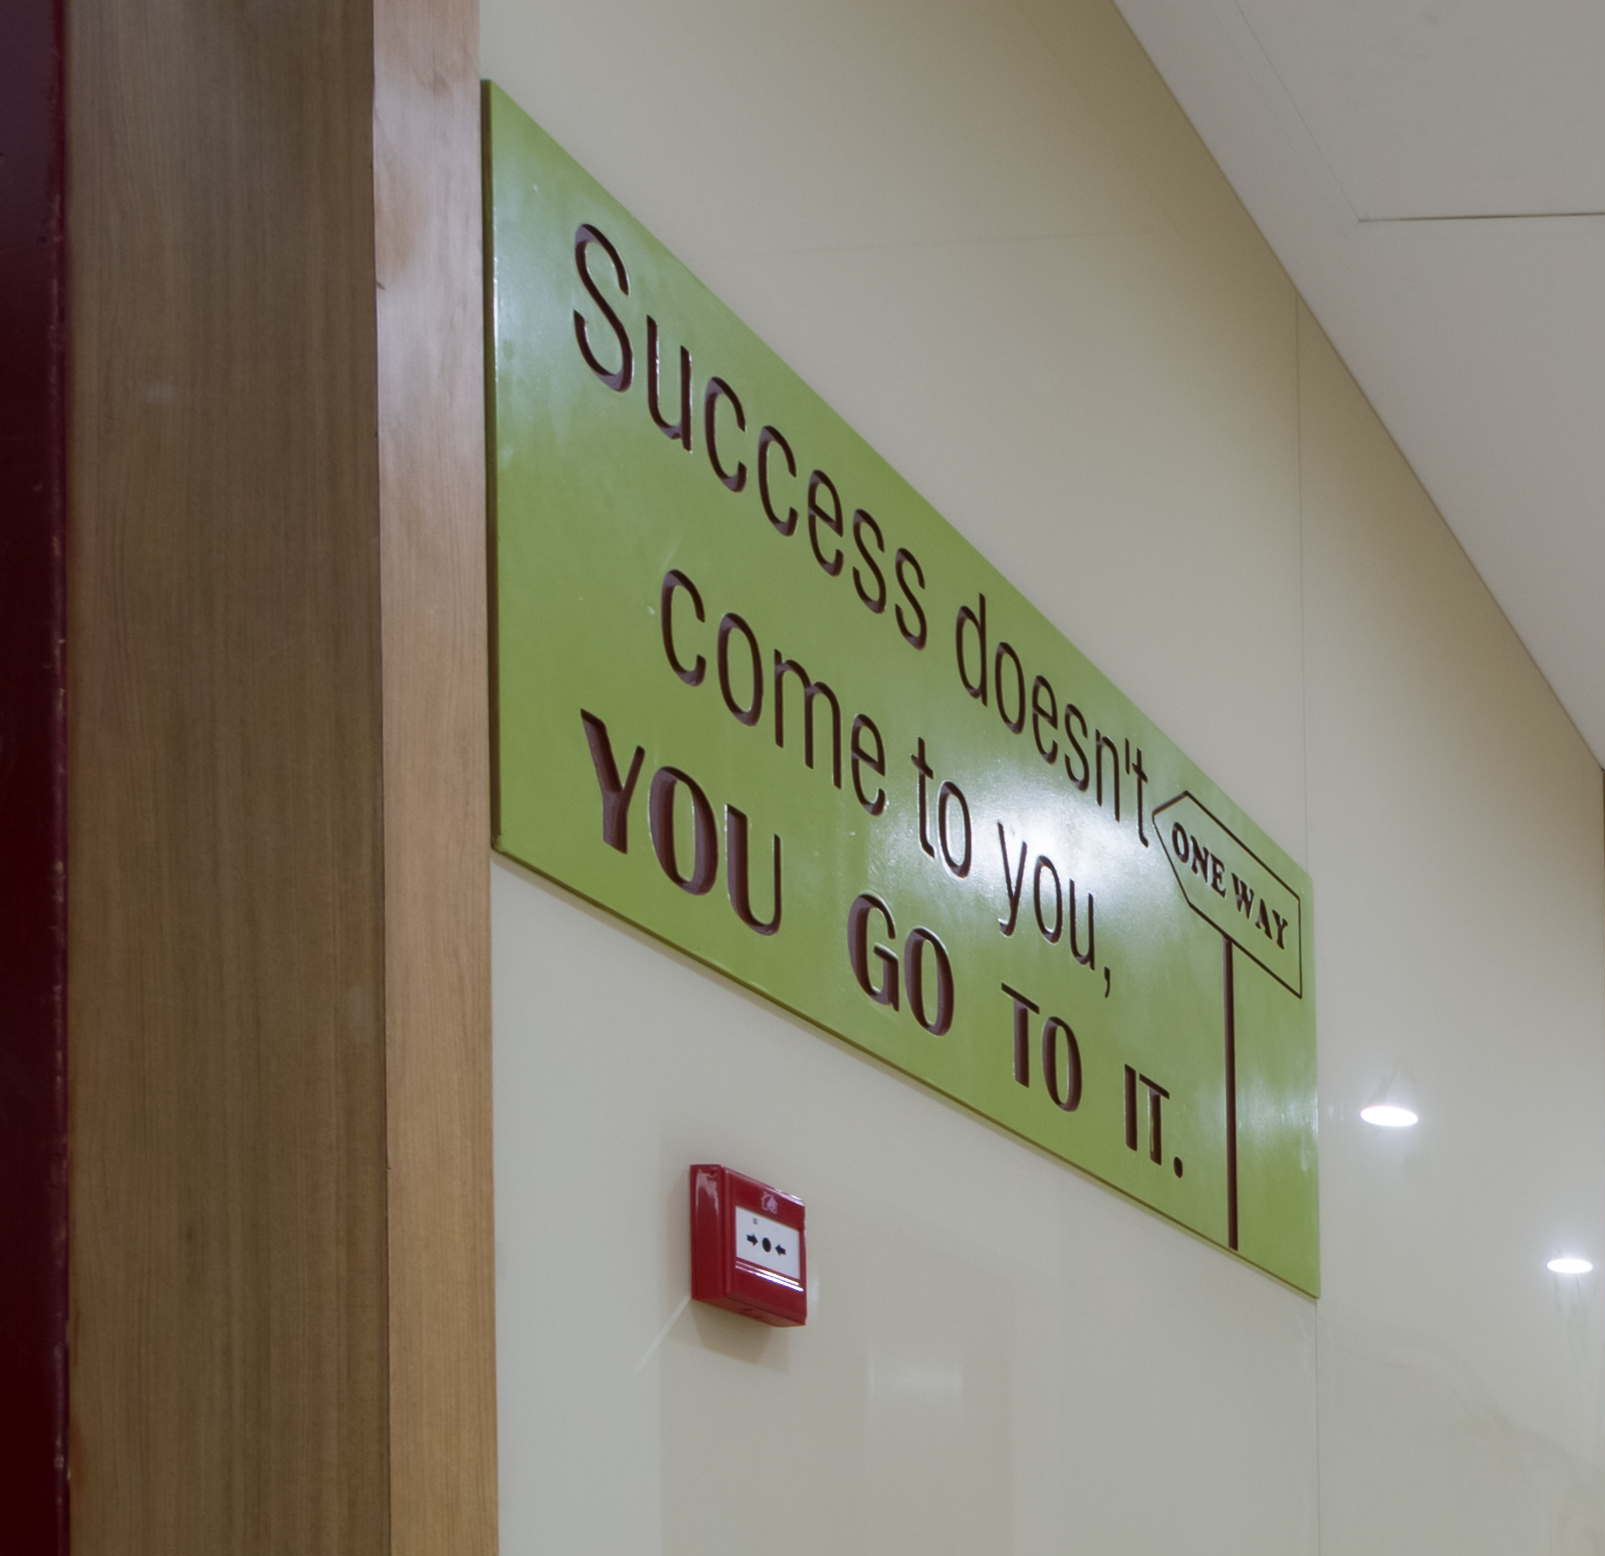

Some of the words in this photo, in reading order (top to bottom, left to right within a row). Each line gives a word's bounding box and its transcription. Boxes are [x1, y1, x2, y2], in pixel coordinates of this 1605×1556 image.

[574, 222, 928, 651] Success
[955, 592, 1149, 849] doesn't
[579, 707, 783, 938] YOU
[848, 892, 955, 1037] GO
[1000, 981, 1083, 1114] TO
[1124, 1064, 1184, 1180] IT.
[660, 567, 886, 817] come
[910, 736, 972, 878] to
[996, 822, 1111, 1000] you,
[1171, 821, 1227, 899] ONE
[1231, 872, 1289, 950] WAY
